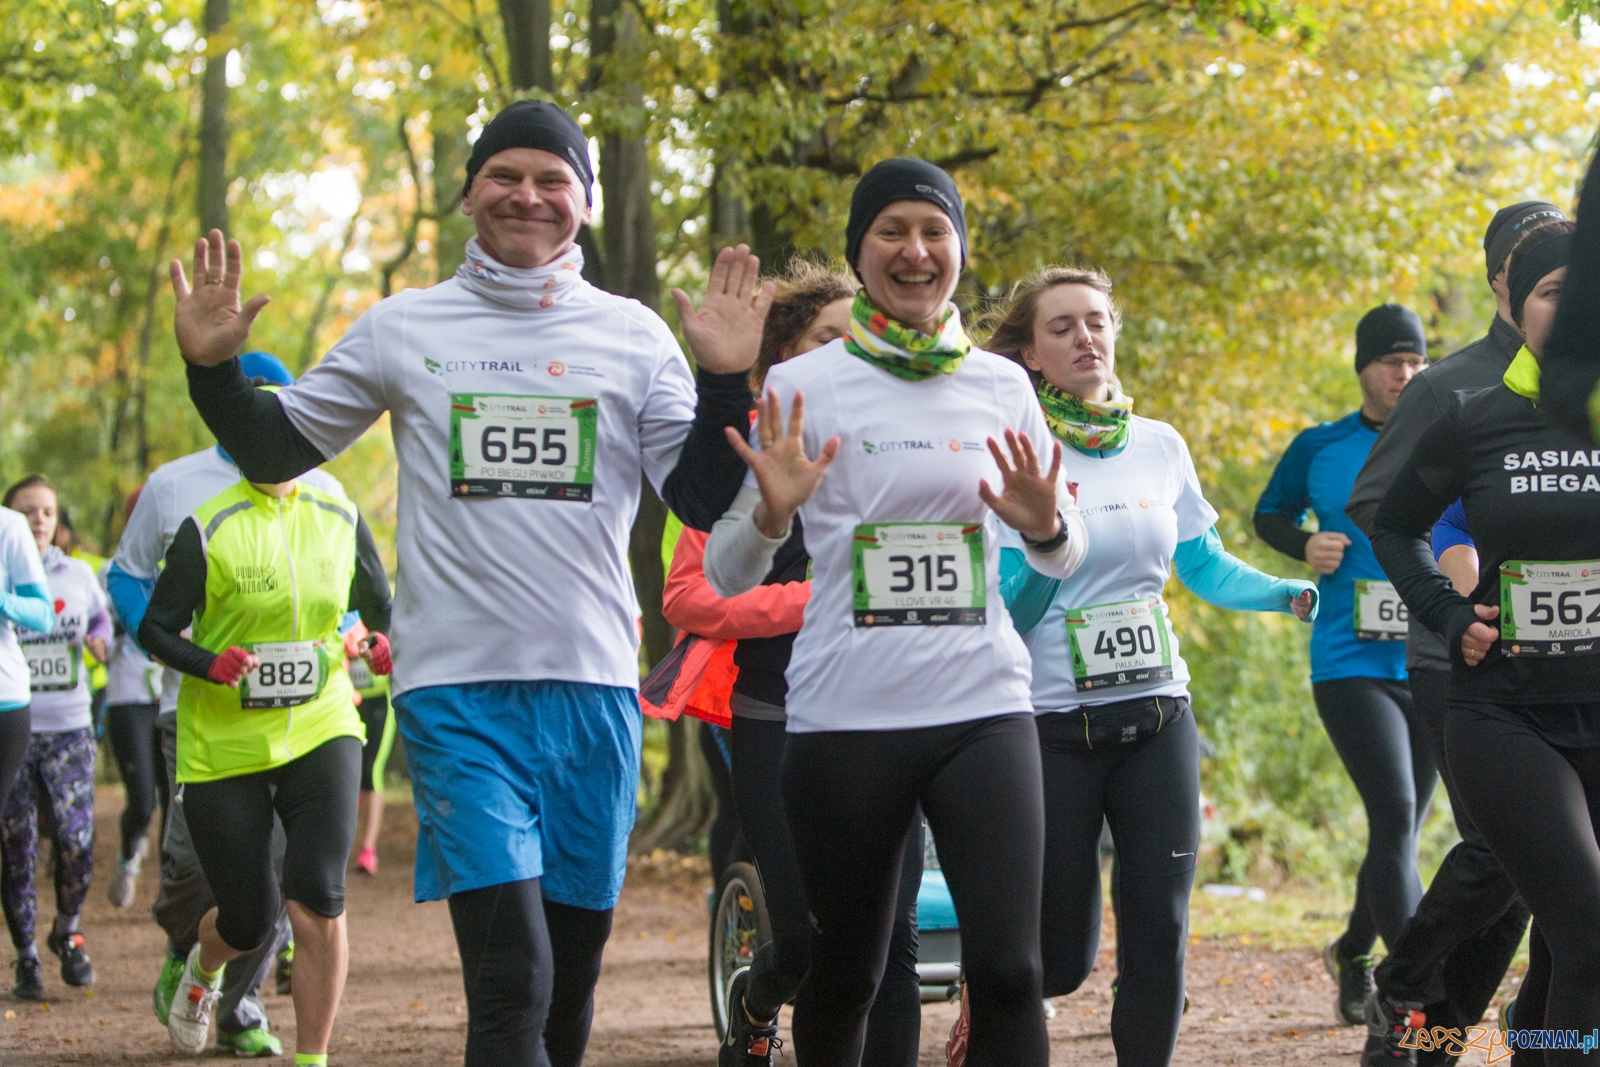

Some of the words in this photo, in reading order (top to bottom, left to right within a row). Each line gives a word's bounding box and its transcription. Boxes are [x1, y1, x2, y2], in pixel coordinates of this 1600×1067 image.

[480, 426, 567, 466] 655
[480, 467, 495, 476] PO
[497, 468, 527, 479] BIEGU
[529, 469, 565, 480] PIWKO!
[1510, 474, 1600, 494] BIEGA
[889, 555, 958, 592] 315
[900, 596, 926, 606] LOVE
[1530, 590, 1600, 626] 562
[1093, 624, 1156, 660] 490
[1549, 628, 1592, 639] MARIOLA
[259, 661, 313, 686] 882
[1115, 659, 1147, 671] PAULINA
